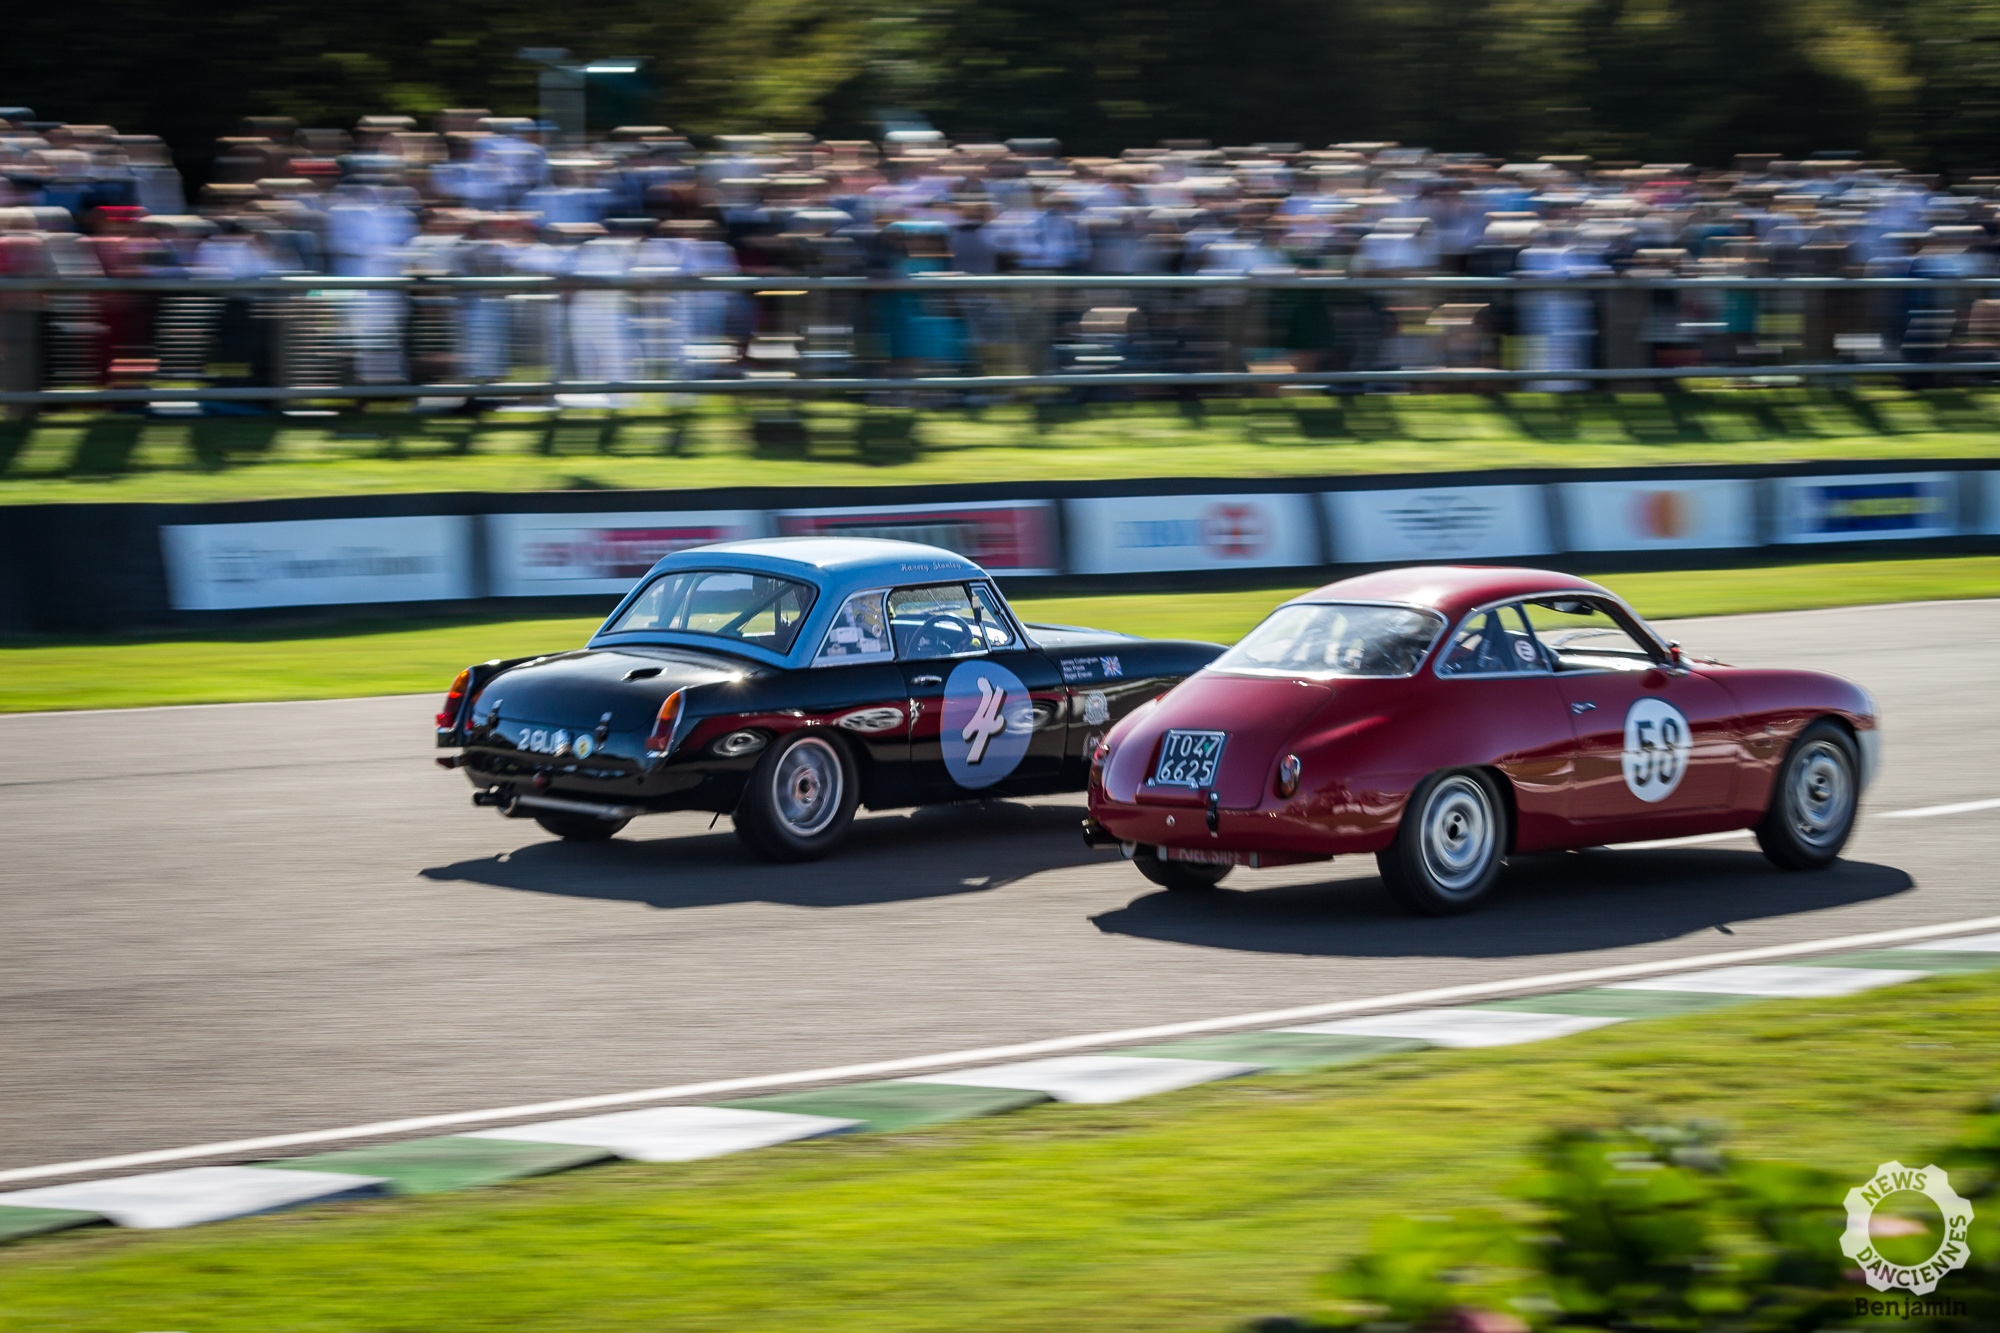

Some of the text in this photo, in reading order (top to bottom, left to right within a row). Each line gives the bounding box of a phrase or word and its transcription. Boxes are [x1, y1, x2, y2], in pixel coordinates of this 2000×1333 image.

[932, 561, 962, 571] Stanley
[962, 677, 1005, 763] 4
[1160, 759, 1214, 782] 6625
